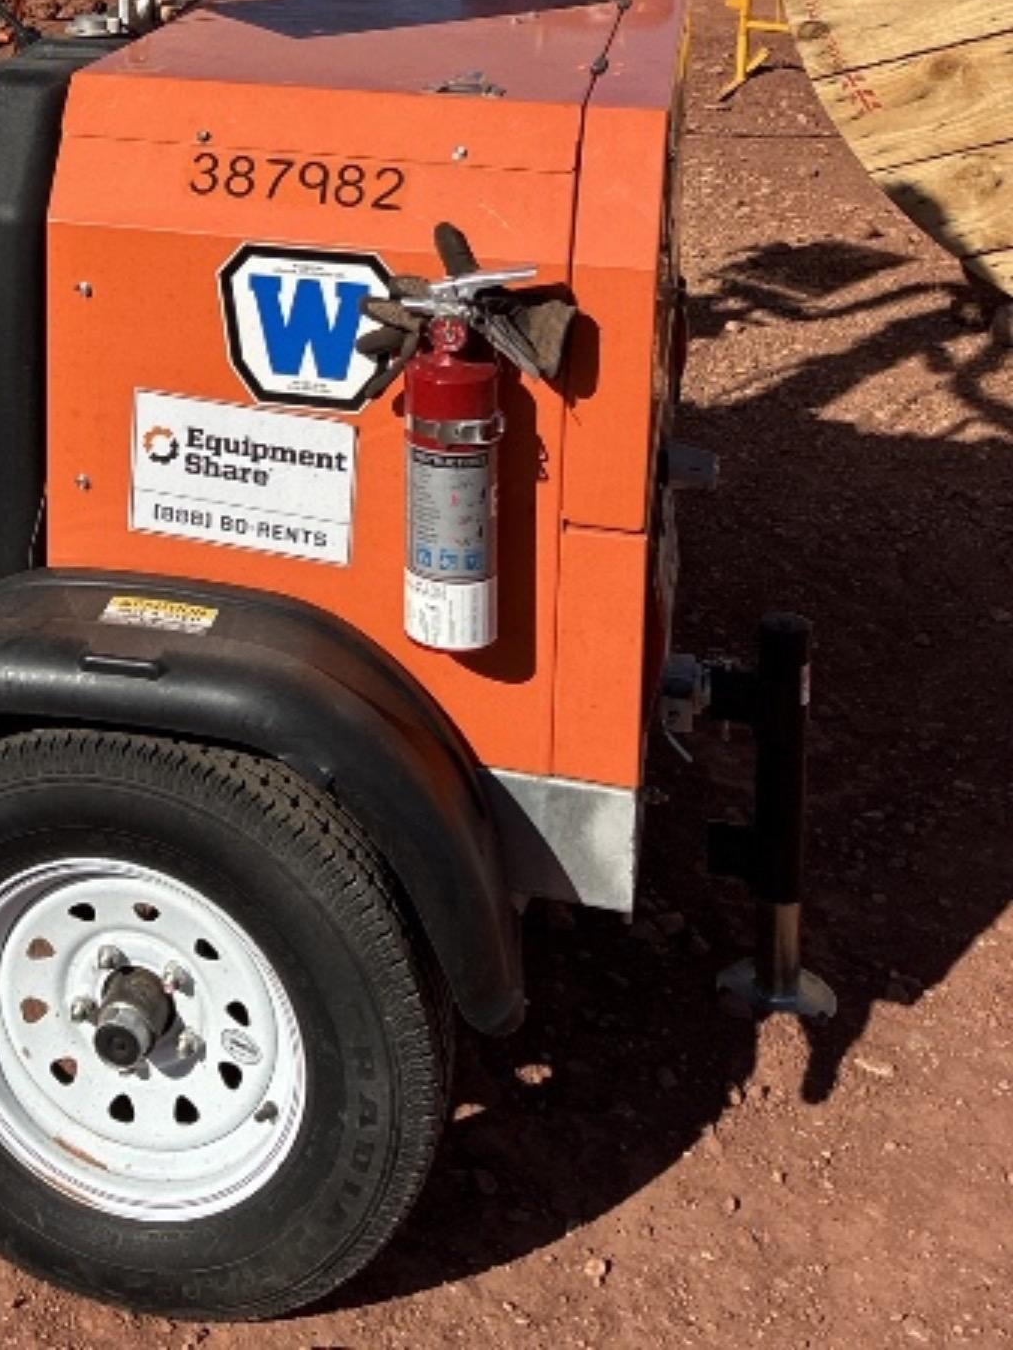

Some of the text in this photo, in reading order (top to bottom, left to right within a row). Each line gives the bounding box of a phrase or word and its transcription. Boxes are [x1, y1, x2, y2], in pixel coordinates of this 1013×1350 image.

[190, 152, 405, 211] 387982
[247, 272, 372, 382] W
[184, 452, 270, 487] Share
[185, 425, 348, 472] Equipment
